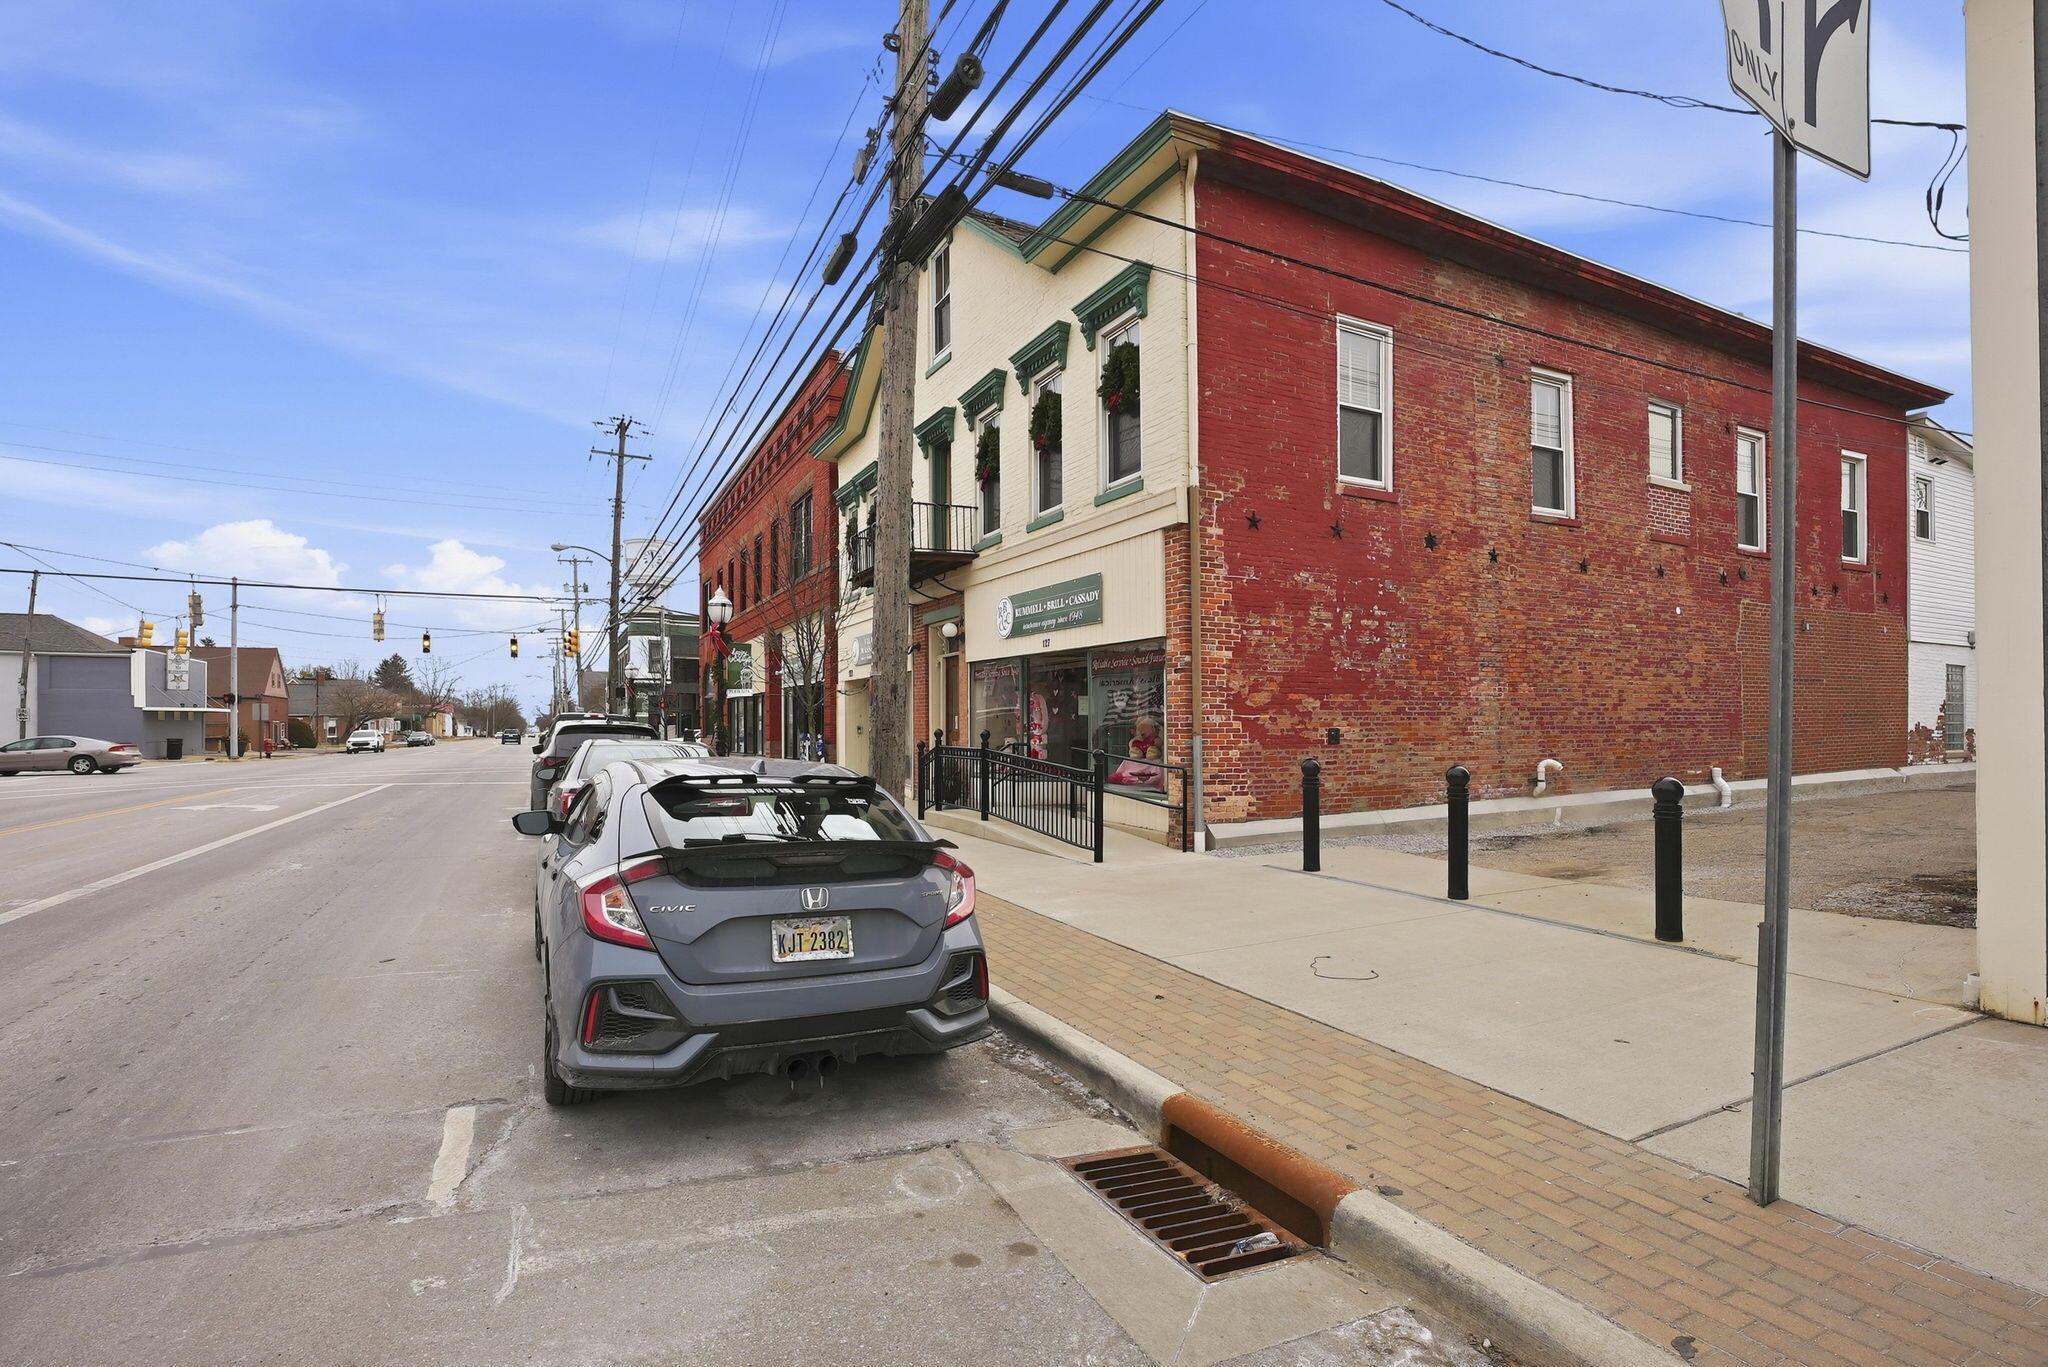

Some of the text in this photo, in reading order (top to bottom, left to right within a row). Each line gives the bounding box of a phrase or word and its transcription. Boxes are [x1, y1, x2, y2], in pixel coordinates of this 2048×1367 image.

[1731, 29, 1778, 101] ONLY
[1068, 589, 1100, 606] CASSADY
[1042, 638, 1051, 648] 127
[649, 904, 696, 913] CIVIC
[778, 930, 844, 954] KJT 2382
